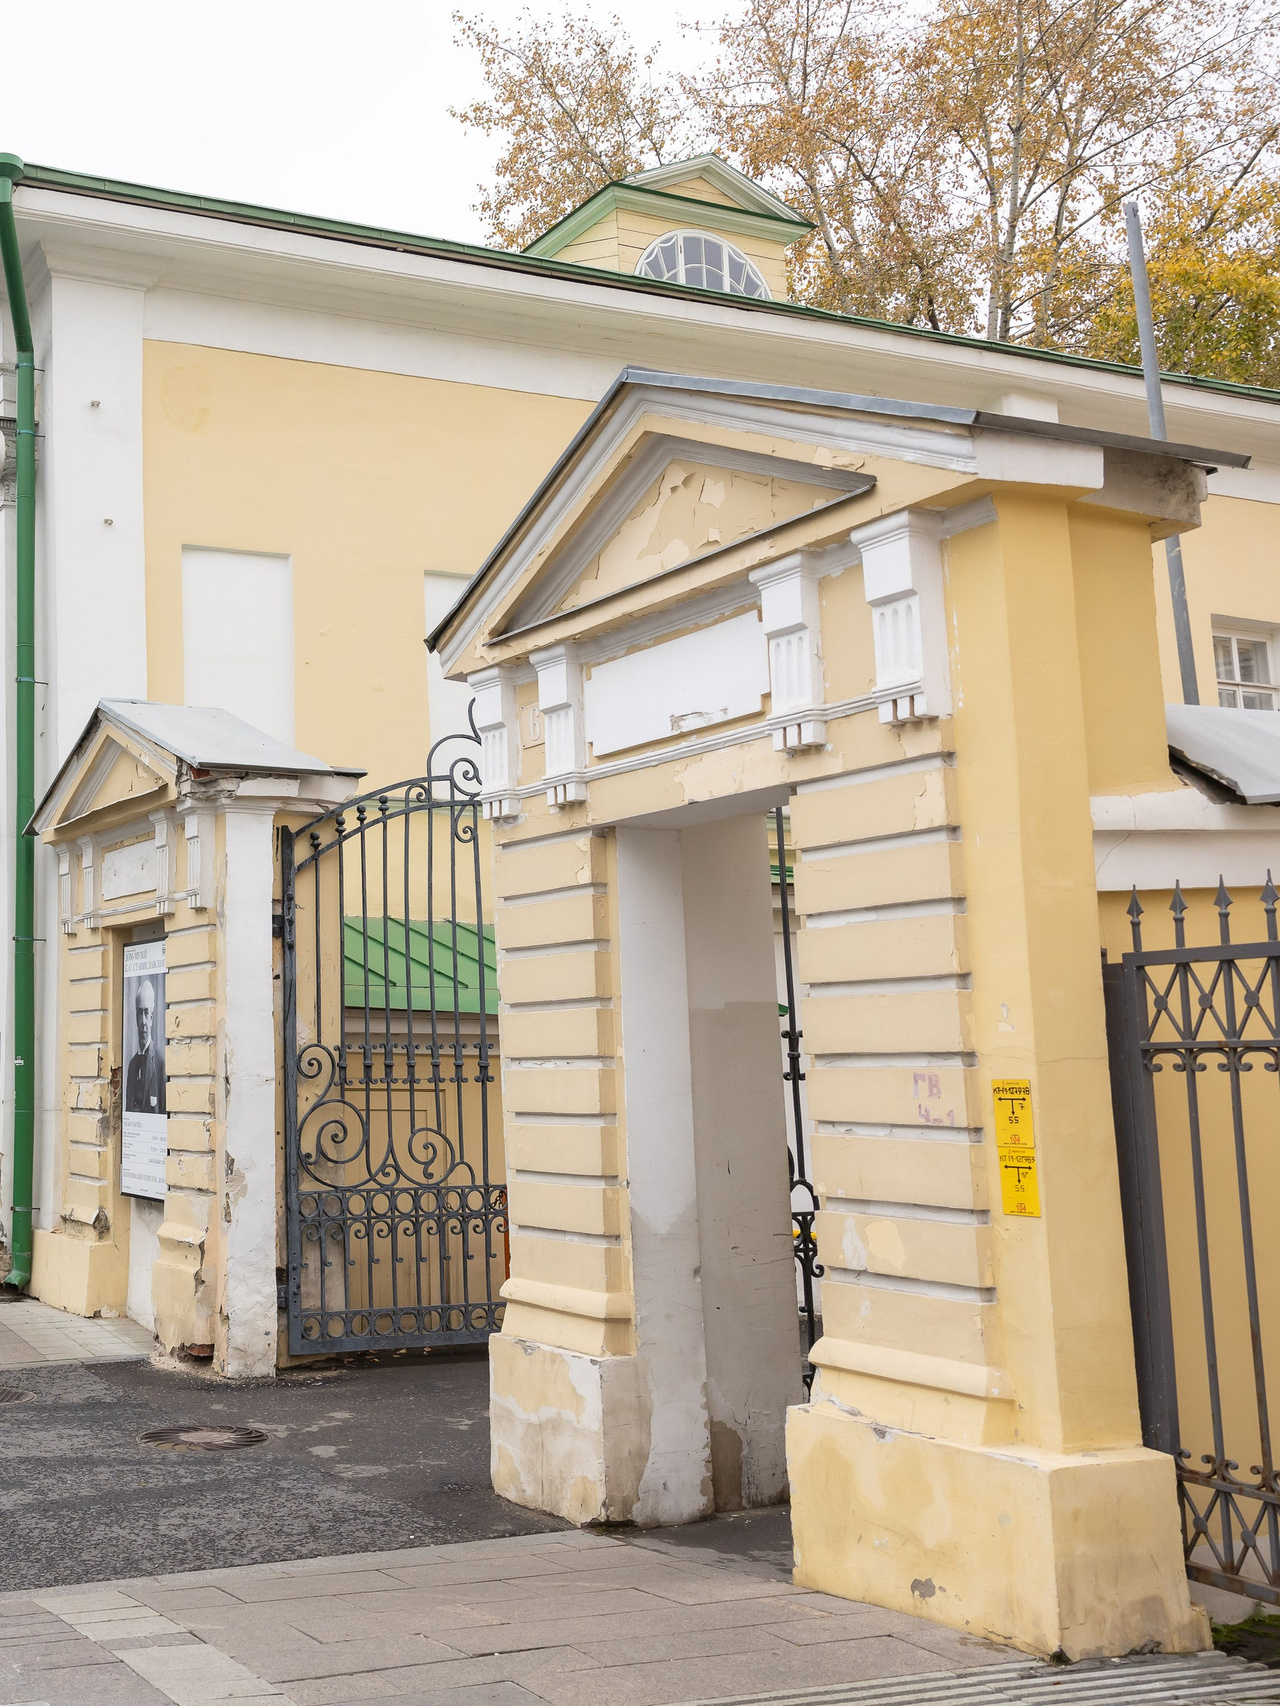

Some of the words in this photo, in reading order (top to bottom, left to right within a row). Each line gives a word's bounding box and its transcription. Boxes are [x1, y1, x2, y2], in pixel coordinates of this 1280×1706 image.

[530, 707, 540, 741] 6
[1009, 1116, 1019, 1124] 55
[1015, 1184, 1025, 1192] 55
